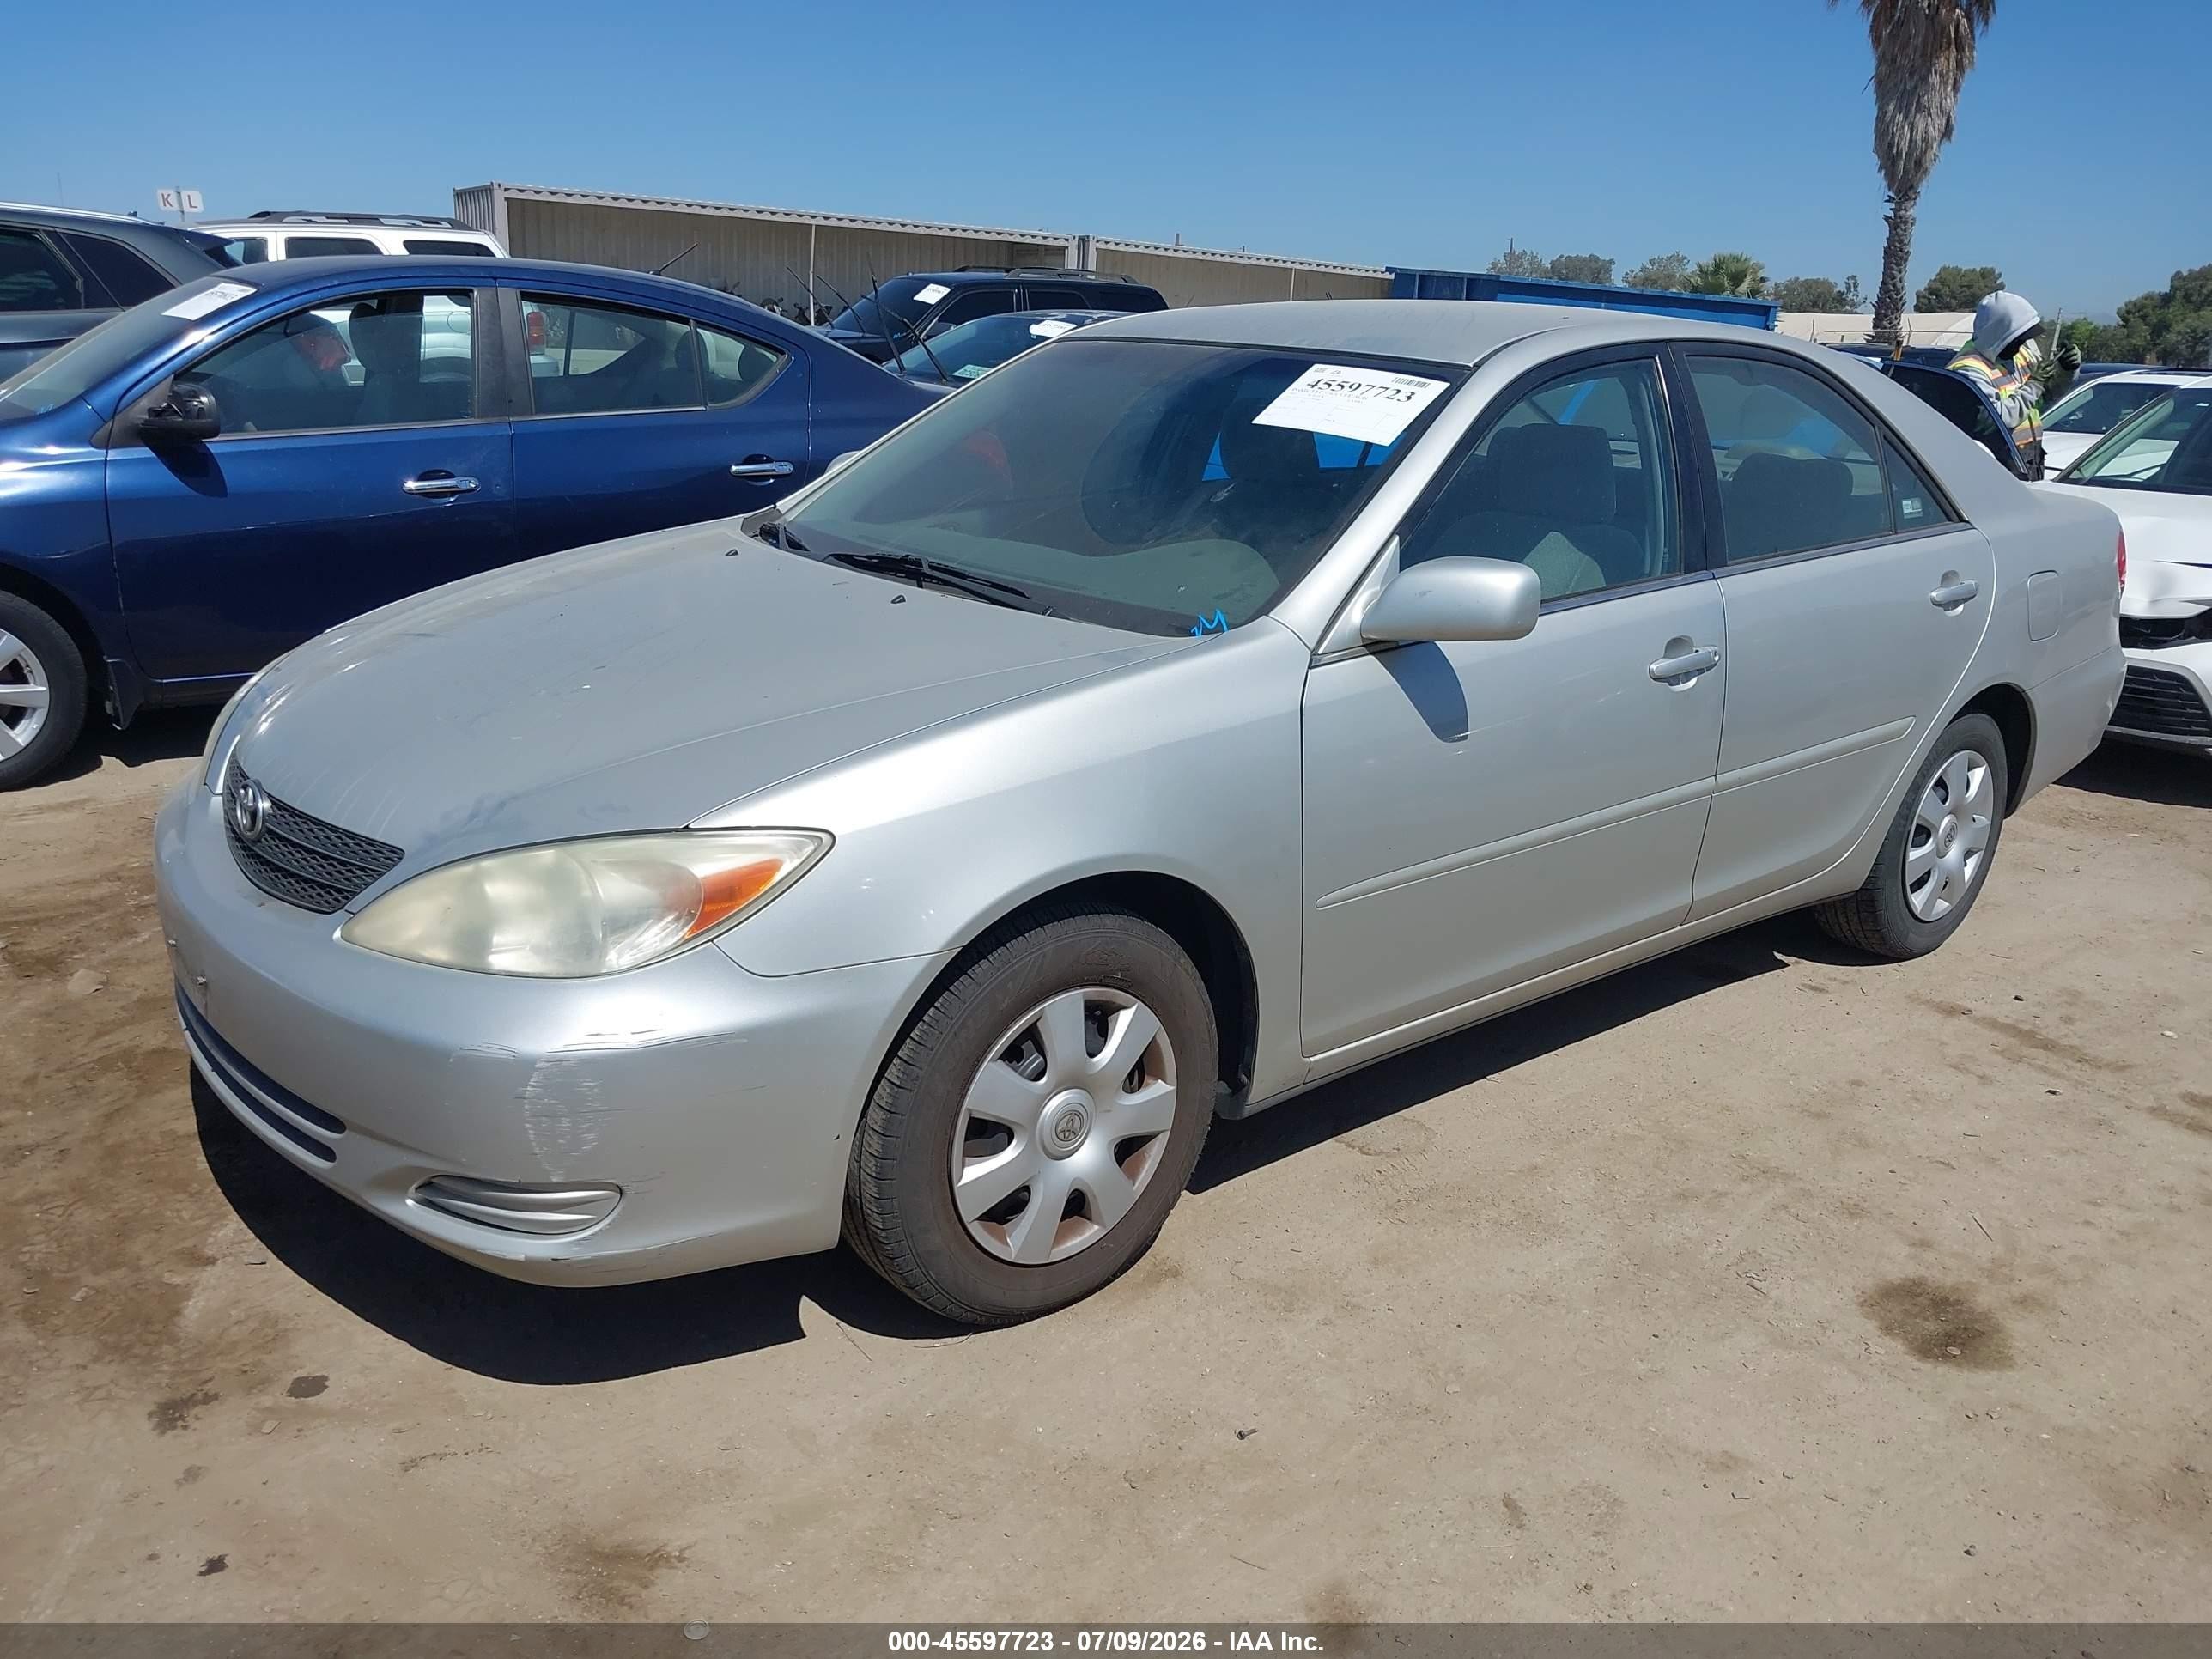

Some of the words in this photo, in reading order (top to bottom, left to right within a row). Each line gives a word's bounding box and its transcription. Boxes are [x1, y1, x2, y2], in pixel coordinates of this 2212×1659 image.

[161, 193, 173, 208] K
[186, 194, 198, 209] L
[1306, 378, 1416, 403] 45597723
